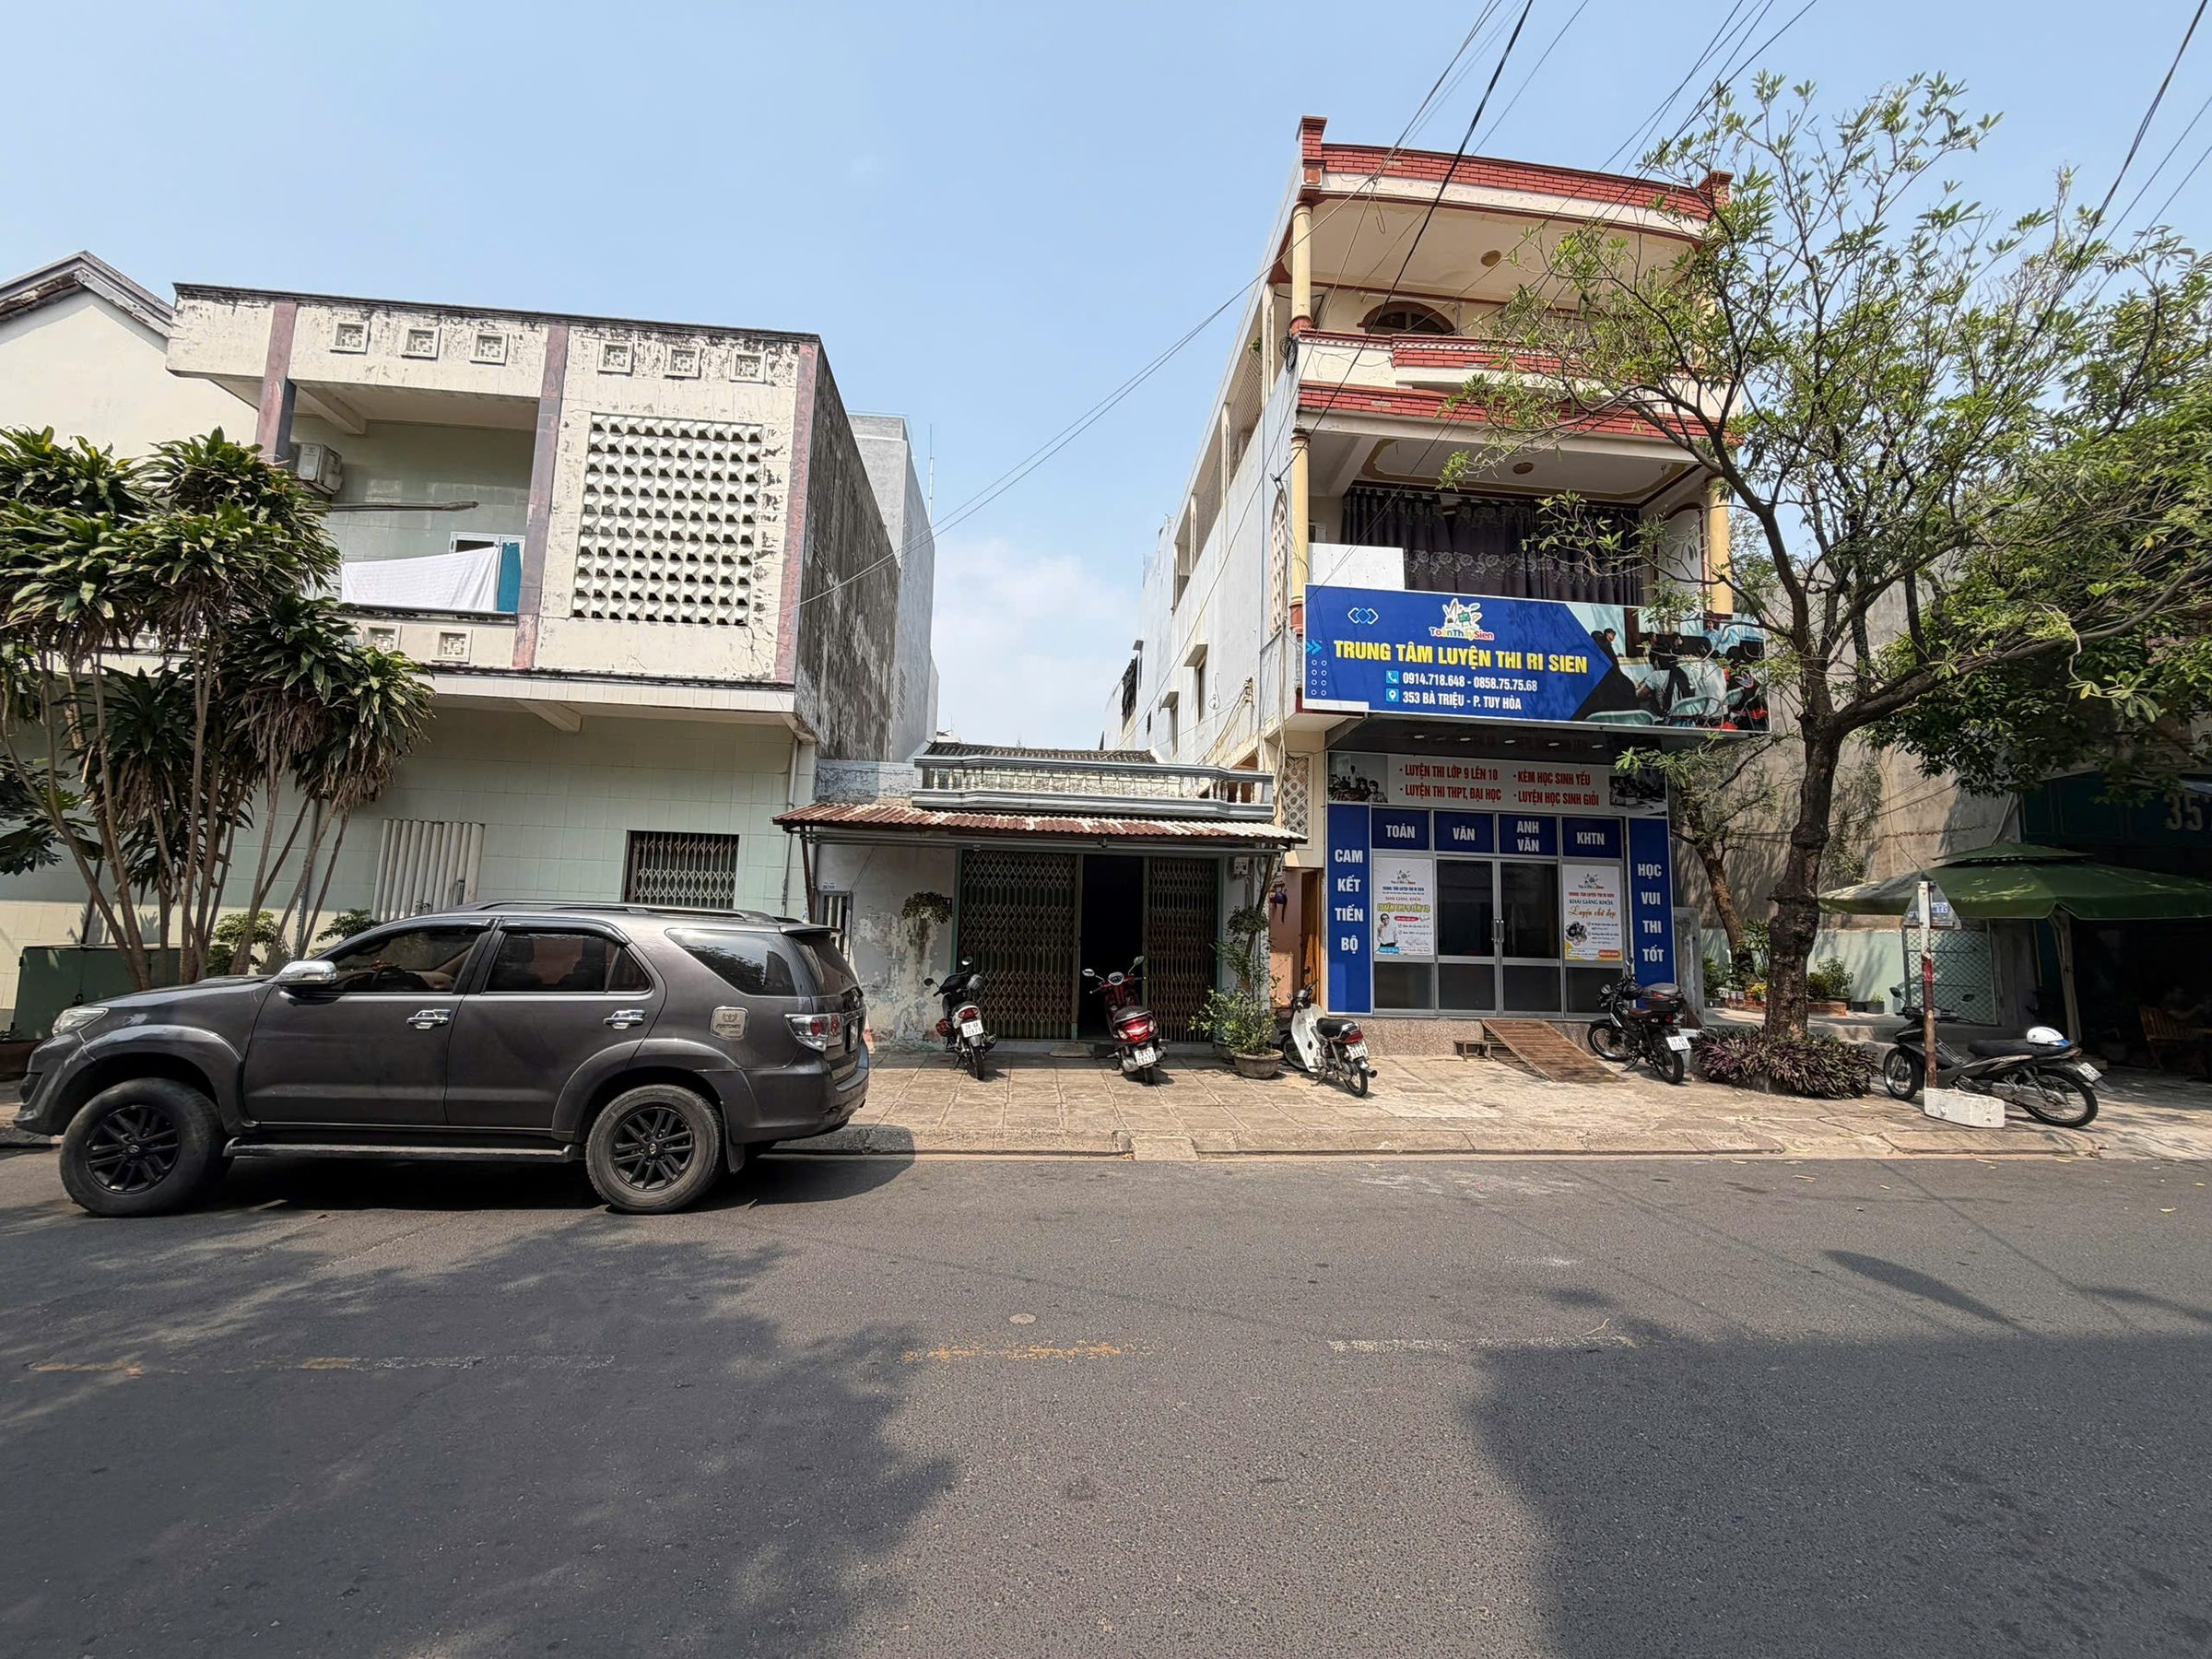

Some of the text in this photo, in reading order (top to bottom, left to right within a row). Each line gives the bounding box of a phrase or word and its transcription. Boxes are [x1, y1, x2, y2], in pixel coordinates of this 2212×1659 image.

[1334, 640, 1588, 674] TRUNG TÂM LUYỆN THI RI SIEN
[1403, 672, 1465, 688] 0914.718.648
[1474, 677, 1538, 691] 0858.75.75.68
[1403, 691, 1420, 704] 353
[1422, 690, 1436, 705] BÀ
[1438, 691, 1465, 709] TRIỆU
[1473, 696, 1481, 708] P.
[1483, 696, 1500, 709] TUY
[1405, 762, 1498, 781] LUYỆN THI LỚP 9 LÊN 10
[1537, 771, 1553, 786] HỌC
[1555, 772, 1574, 785] SINH
[1576, 771, 1591, 786] YẾU
[1405, 782, 1501, 803] LUYỆN THI THPT, ĐẠI HỌC
[1518, 788, 1599, 806] LUYỆN HỌC SINH GIỎI
[2163, 793, 2212, 831] 35
[1385, 822, 1416, 839] TOÁN
[1453, 825, 1476, 841] VĂN
[1516, 820, 1539, 834] ANH
[1517, 836, 1539, 853] VĂN
[1576, 831, 1605, 846] KHTN
[1335, 849, 1363, 864] CAM
[1637, 863, 1663, 879] HỌC
[1337, 874, 1361, 892] KẾT
[1641, 891, 1661, 905] VUI
[1335, 903, 1364, 922] TIẾN
[1642, 920, 1663, 934] THI
[1341, 935, 1359, 954] BỘ
[1642, 944, 1665, 962] TỐT
